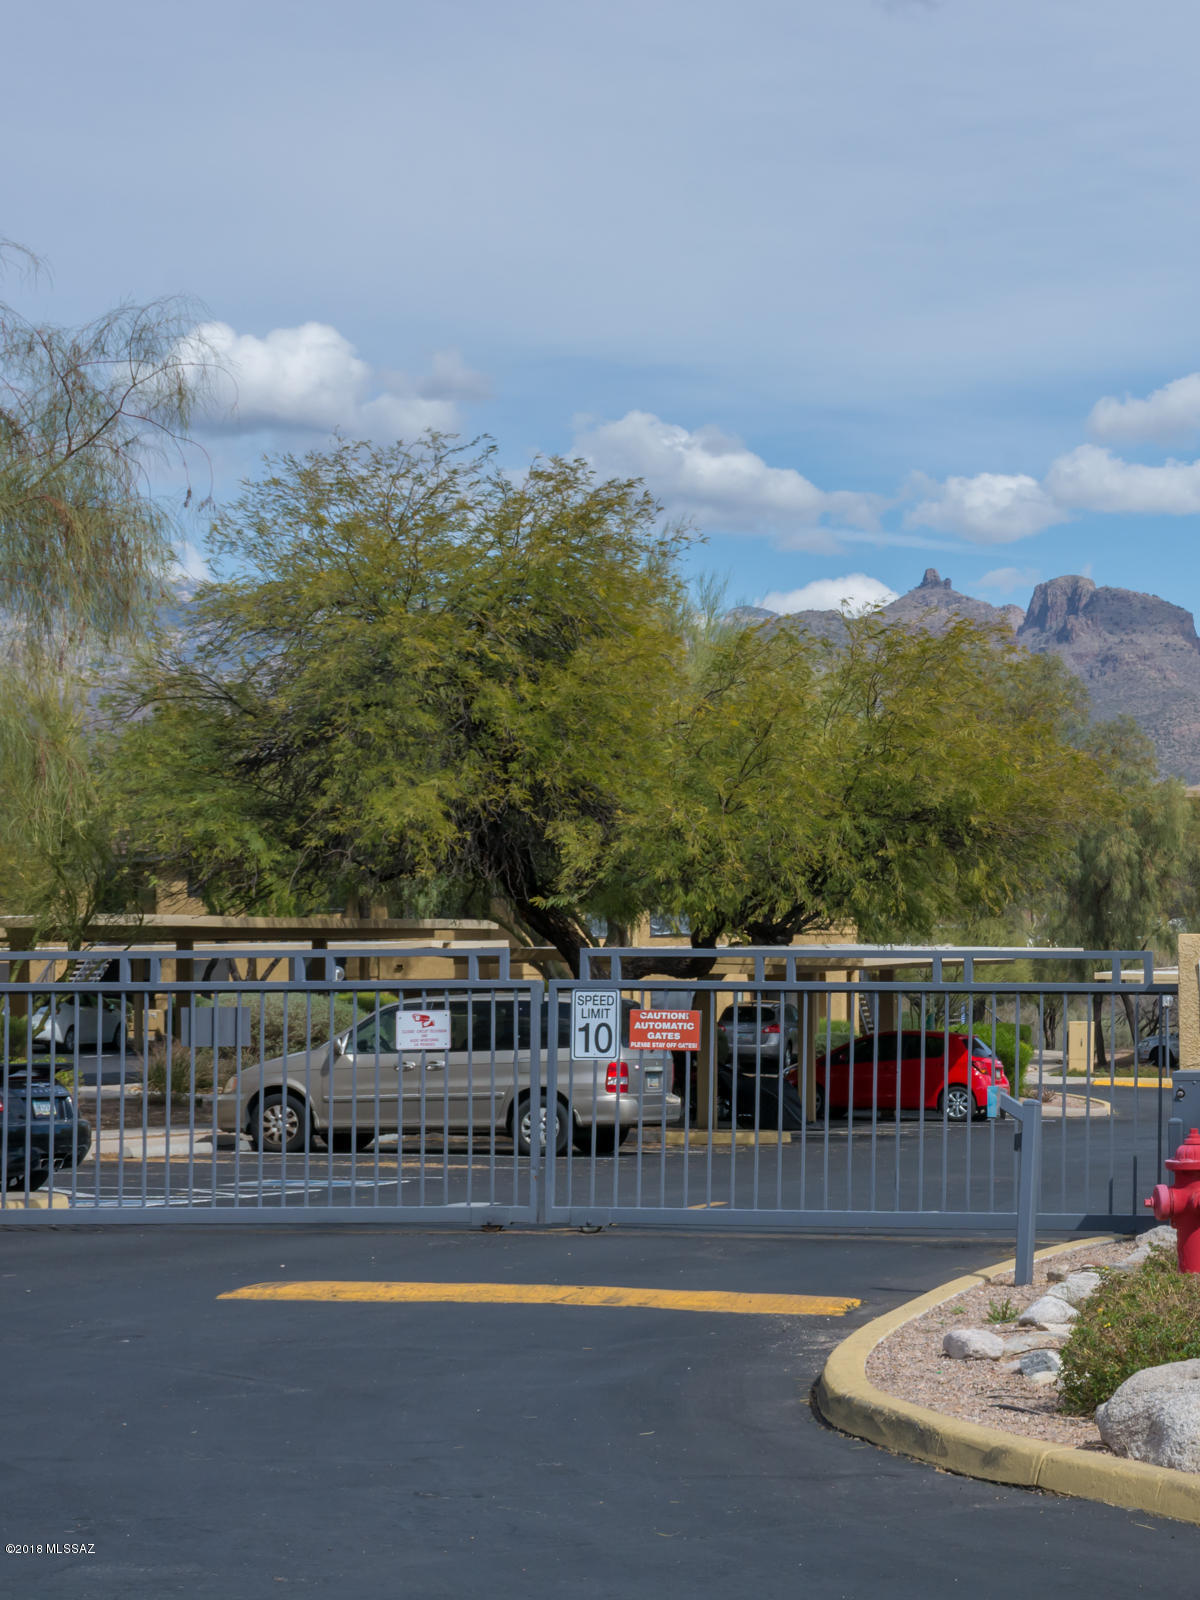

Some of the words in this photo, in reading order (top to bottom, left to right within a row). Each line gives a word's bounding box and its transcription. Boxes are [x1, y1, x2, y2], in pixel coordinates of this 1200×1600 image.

[578, 994, 614, 1006] SPEED
[581, 1008, 610, 1019] LIMIT
[634, 1022, 695, 1030] AUTOMATIC
[578, 1022, 612, 1053] 10
